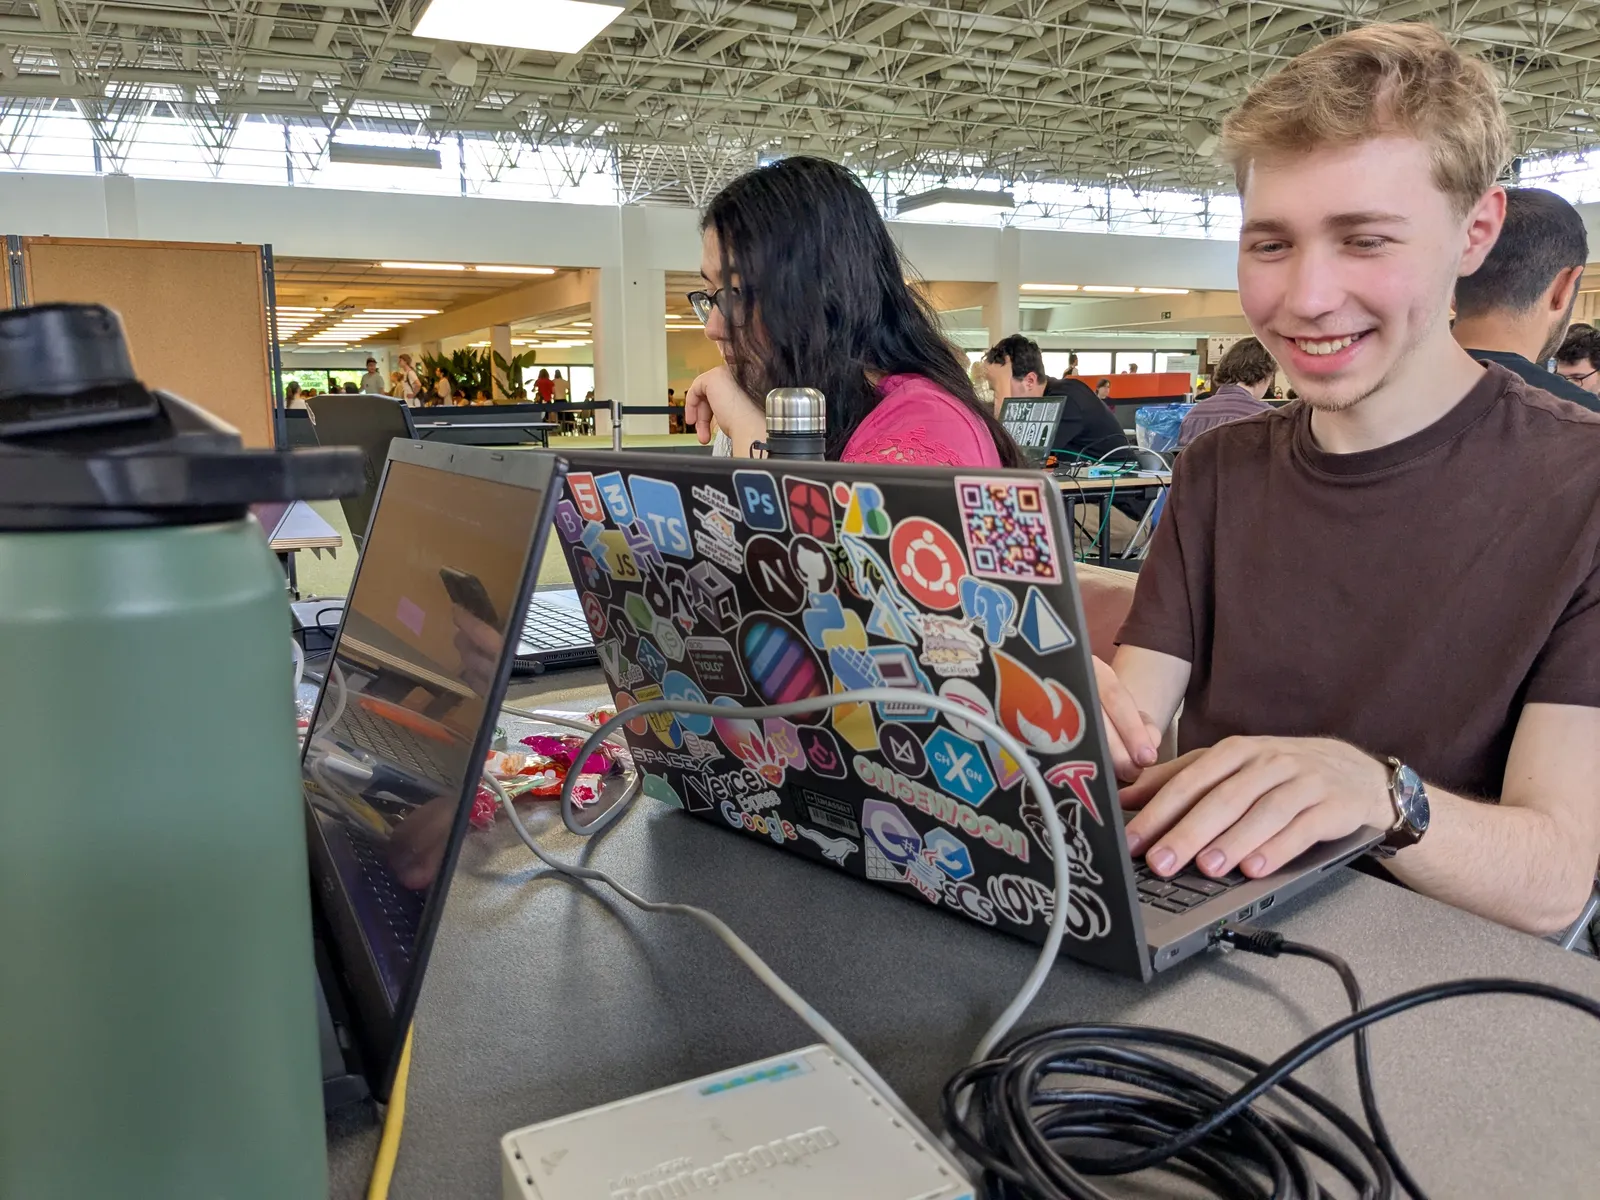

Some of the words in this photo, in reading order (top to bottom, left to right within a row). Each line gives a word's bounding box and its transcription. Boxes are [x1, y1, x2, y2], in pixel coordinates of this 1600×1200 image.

[693, 489, 740, 519] PROGRAMMER
[744, 487, 775, 515] Ps
[561, 512, 577, 532] B
[648, 512, 687, 552] TS
[616, 554, 636, 576] JS
[689, 767, 767, 802] Vercel
[721, 800, 797, 843] Google
[870, 810, 915, 857] C#
[904, 869, 937, 902] Java
